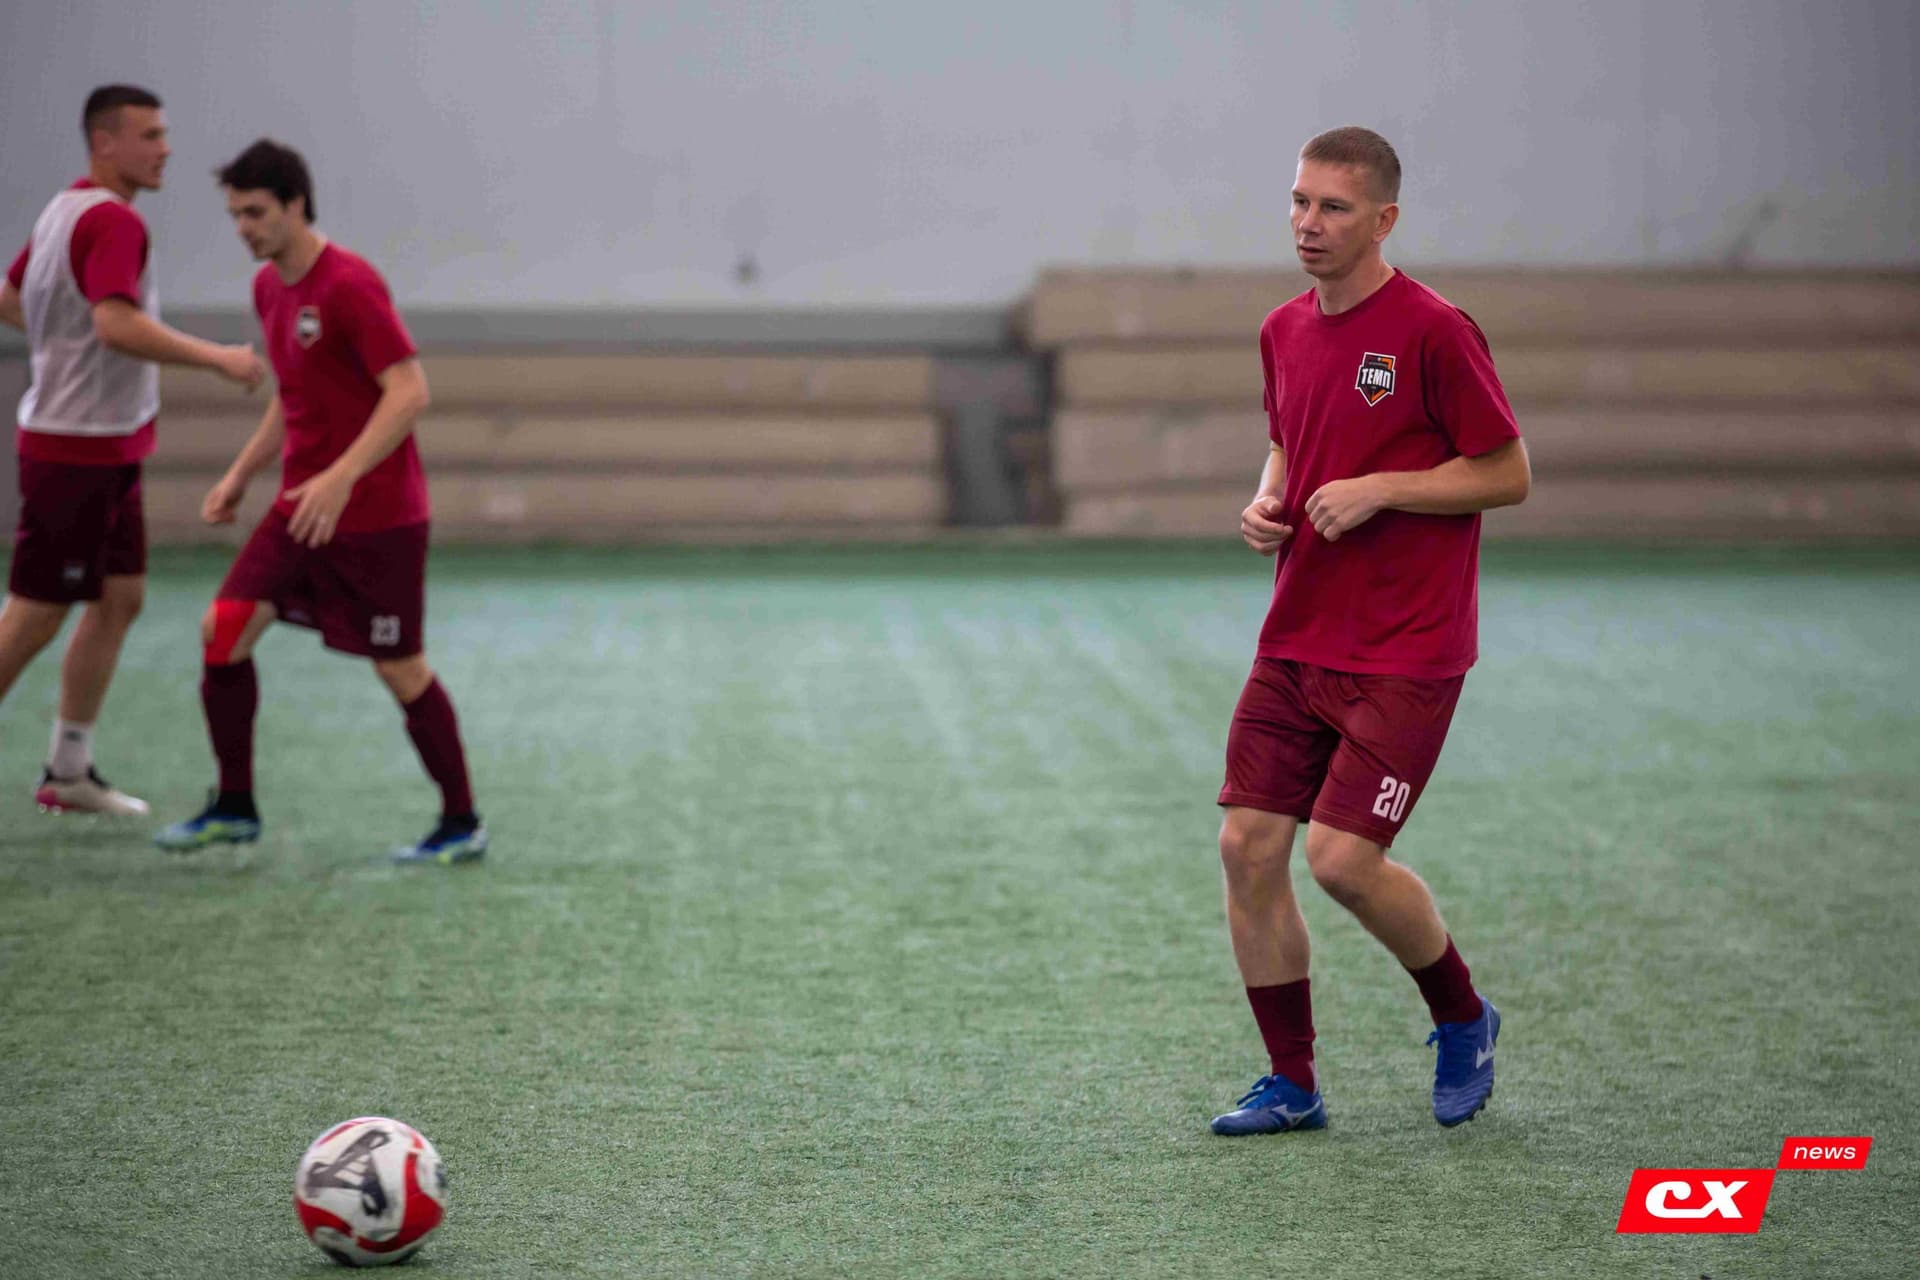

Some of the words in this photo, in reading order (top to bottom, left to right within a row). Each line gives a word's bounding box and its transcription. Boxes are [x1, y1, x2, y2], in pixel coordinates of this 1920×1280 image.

[1361, 368, 1392, 389] ТЕМП
[370, 615, 400, 646] 23
[1372, 776, 1411, 822] 20
